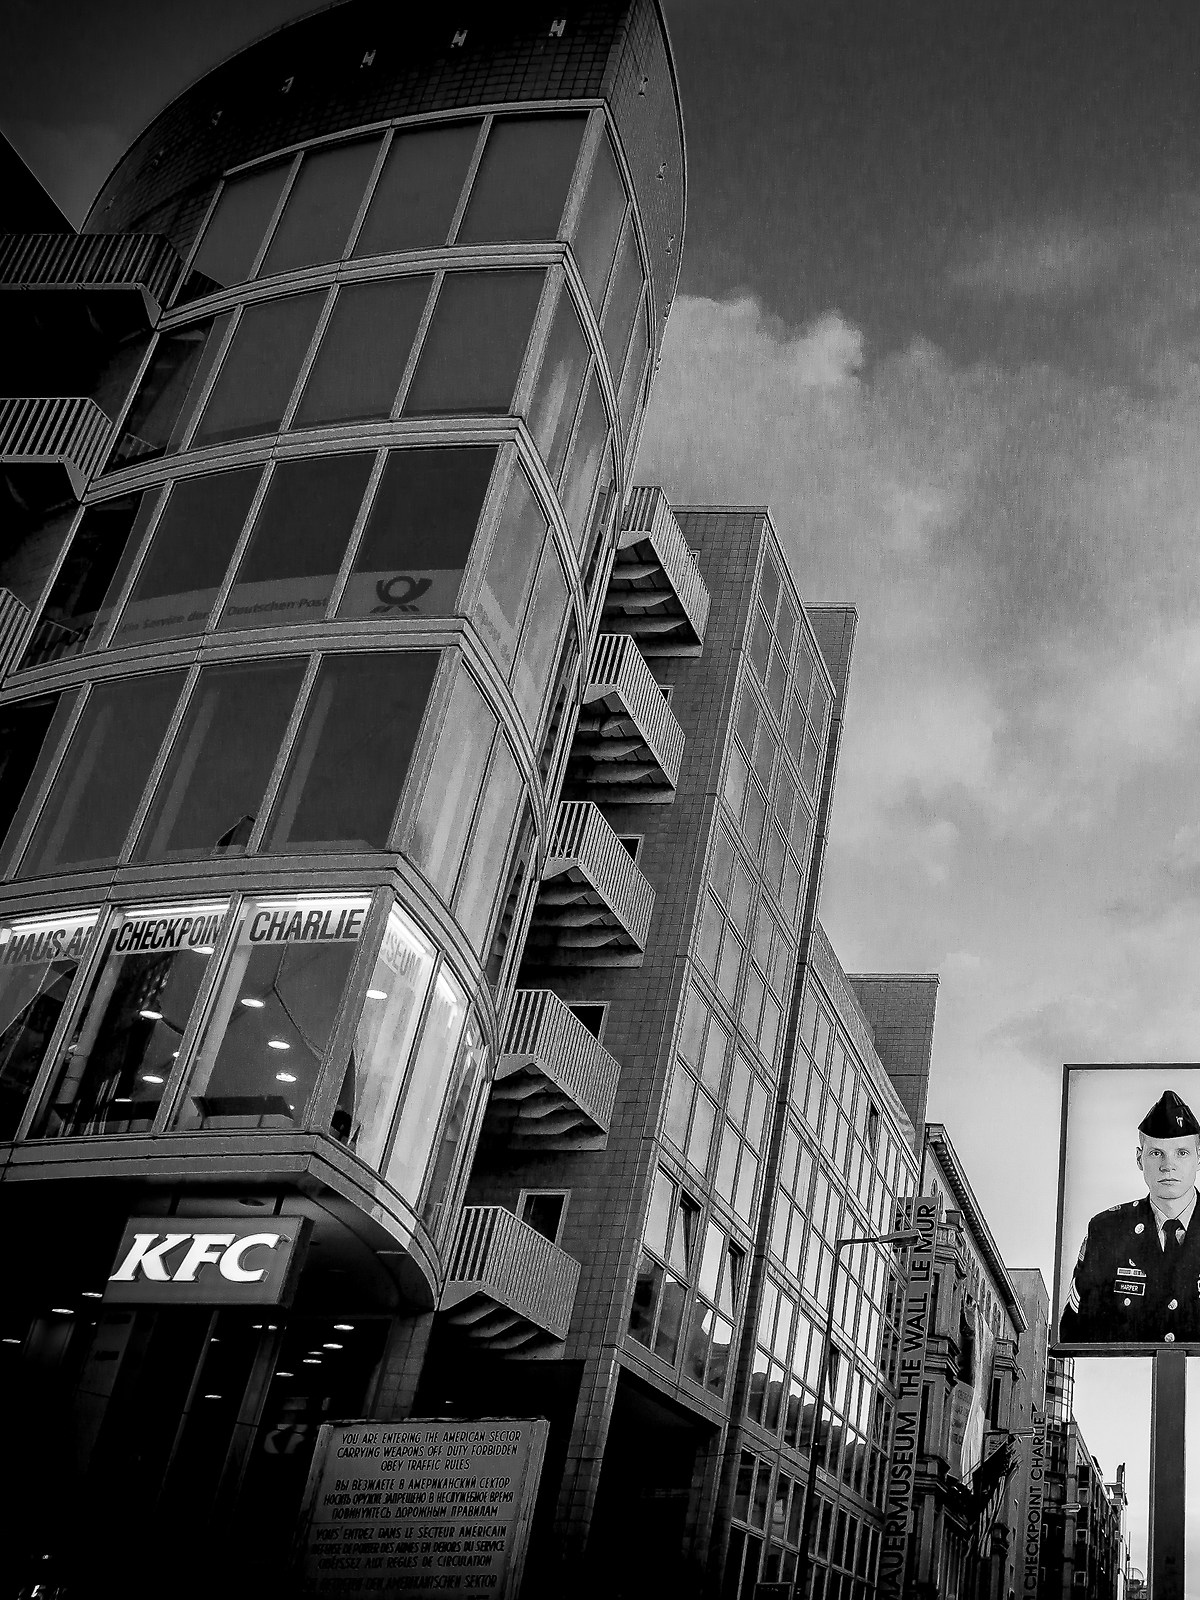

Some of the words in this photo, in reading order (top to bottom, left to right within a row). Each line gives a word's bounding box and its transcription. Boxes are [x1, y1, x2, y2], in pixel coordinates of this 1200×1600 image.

[3, 929, 66, 965] HAUS
[115, 914, 226, 952] CHECKPOIN
[248, 908, 365, 943] CHARLIE
[913, 1205, 936, 1253] MUR
[108, 1232, 281, 1283] KFC
[911, 1261, 931, 1281] LE
[903, 1292, 928, 1353] WALL
[901, 1359, 921, 1400] THE
[342, 1433, 359, 1444] YOU
[362, 1432, 378, 1444] ARE
[382, 1432, 421, 1444] ENTERING
[425, 1431, 438, 1443] THE
[443, 1431, 485, 1442] AMERICAN
[489, 1430, 521, 1442] SECTOR
[337, 1447, 381, 1458] CARRYING
[383, 1446, 424, 1458] WEAPONS
[427, 1445, 443, 1457] OFF
[447, 1445, 469, 1457] DUTY
[471, 1444, 518, 1456] FORBIDDEN
[1030, 1417, 1046, 1480] CHARLIE
[380, 1460, 404, 1471] OBEY
[407, 1459, 441, 1471] TRAFFIC
[445, 1458, 470, 1470] RULES
[334, 1479, 350, 1491] ВЫ
[398, 1478, 405, 1490] В
[407, 1476, 476, 1490] АМЕРИКАНСКИЙ
[480, 1477, 510, 1489] СЕКТОР
[428, 1492, 435, 1503] В
[490, 1491, 514, 1503] ВРЕМЯ
[395, 1506, 447, 1518] ДОРОЖНЫМ
[450, 1505, 499, 1517] ПРАВИЛАМ
[378, 1527, 402, 1539] DANS
[404, 1527, 414, 1539] LE
[459, 1523, 507, 1537] AMÉRICAIN
[1023, 1486, 1043, 1590] CHECKPOINT
[464, 1541, 474, 1552] DU
[475, 1540, 505, 1552] SERVICE
[422, 1556, 433, 1567] DE
[437, 1555, 492, 1568] CIRCULATION
[464, 1574, 498, 1588] SEKTOR
